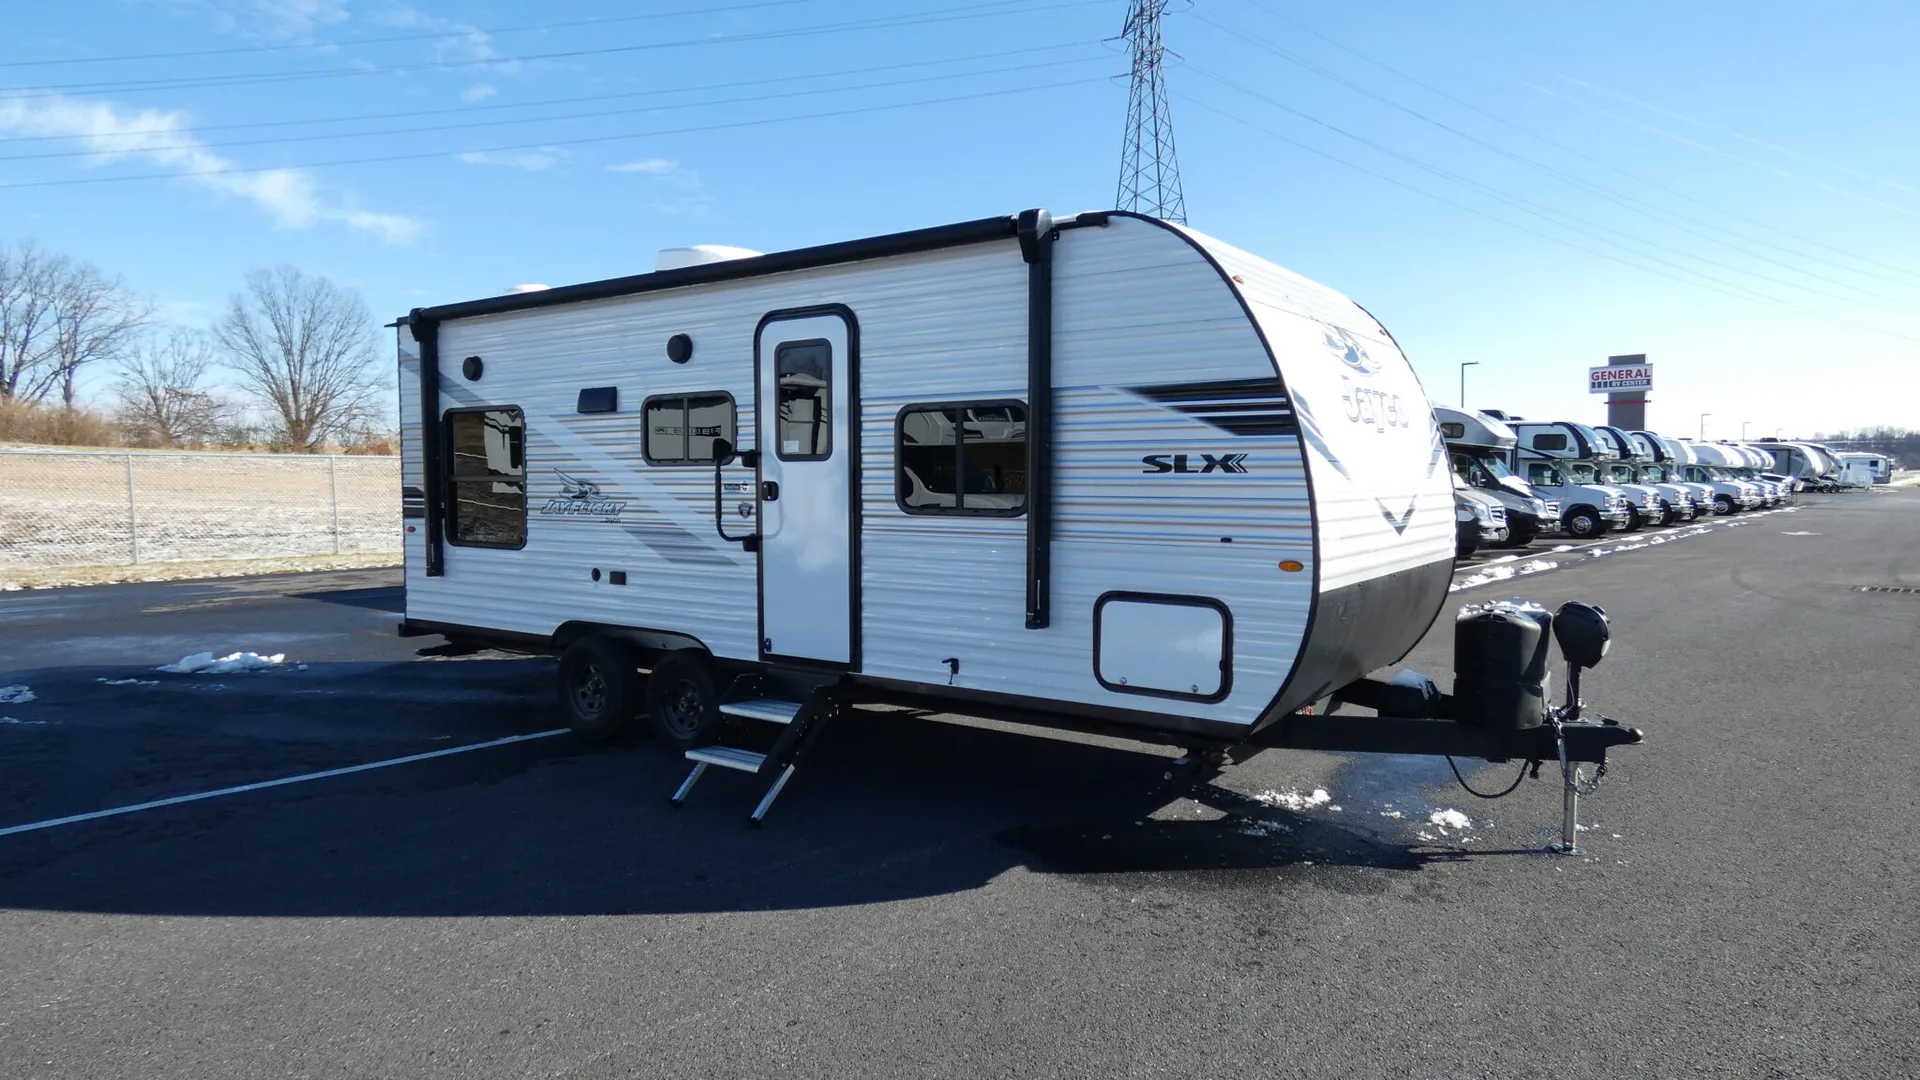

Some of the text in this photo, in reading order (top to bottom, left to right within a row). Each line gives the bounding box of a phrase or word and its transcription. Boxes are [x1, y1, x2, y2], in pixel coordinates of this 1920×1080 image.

[1591, 369, 1651, 381] GENERAL
[1341, 375, 1410, 433] Jayco
[1142, 453, 1248, 473] SLX
[541, 500, 627, 516] JAY FLIGHT
